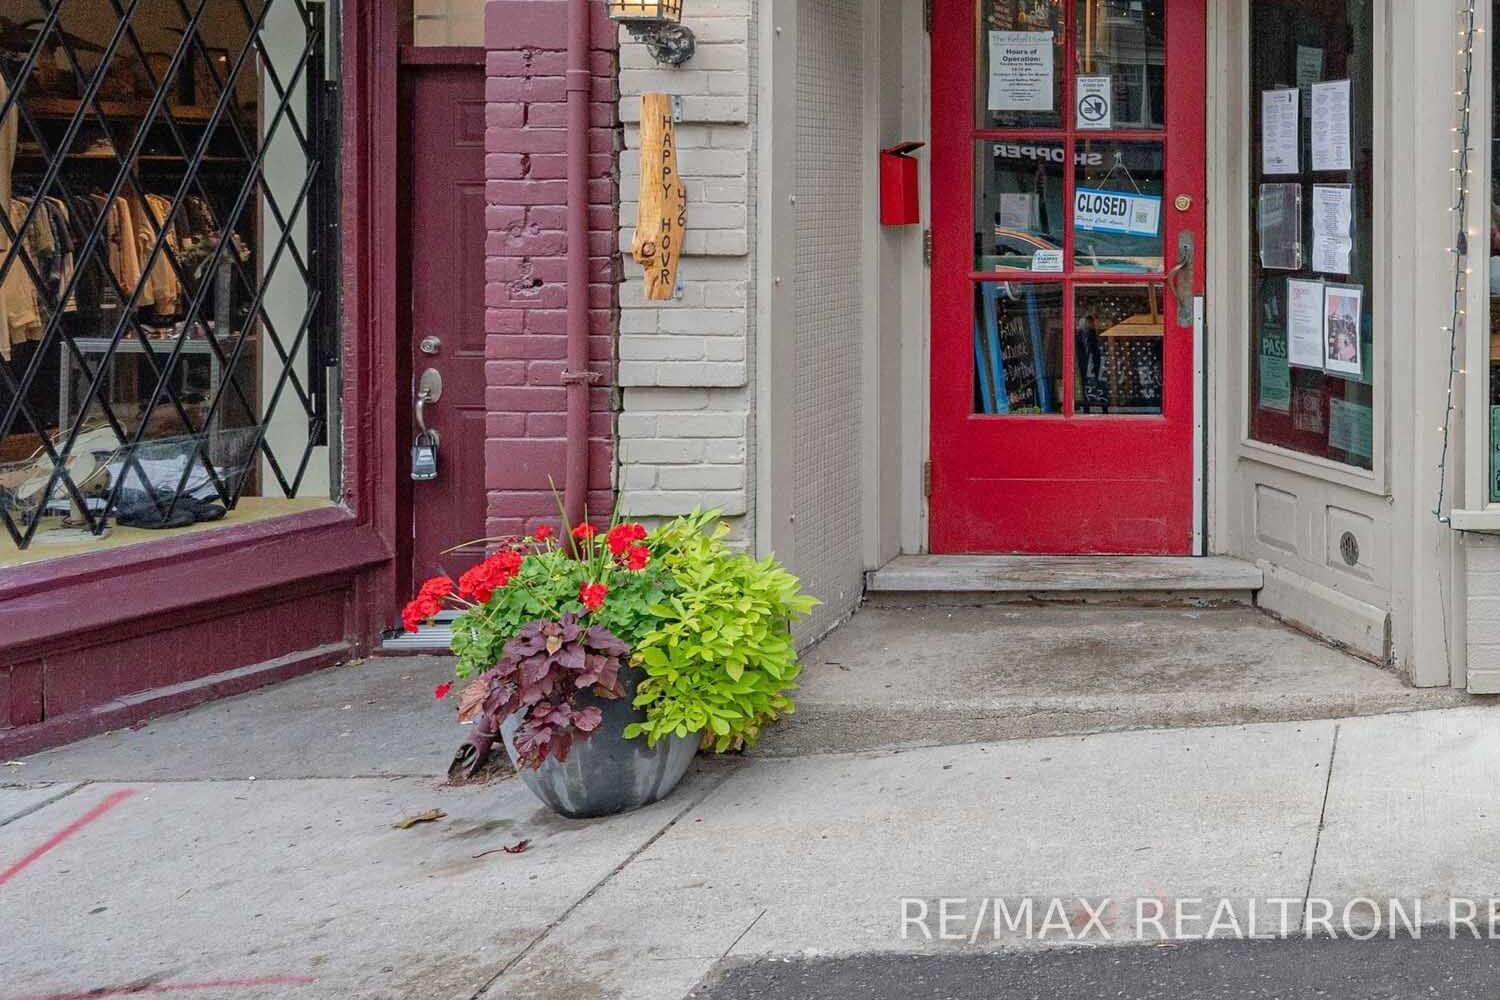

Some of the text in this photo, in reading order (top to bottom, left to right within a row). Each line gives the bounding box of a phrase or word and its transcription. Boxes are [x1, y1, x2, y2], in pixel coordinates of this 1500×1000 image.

[1006, 48, 1028, 56] Hours
[662, 115, 672, 199] HAPPY
[677, 187, 687, 207] 4
[1077, 193, 1127, 217] CLOSED
[677, 207, 688, 228] 6
[1262, 337, 1287, 358] PASS
